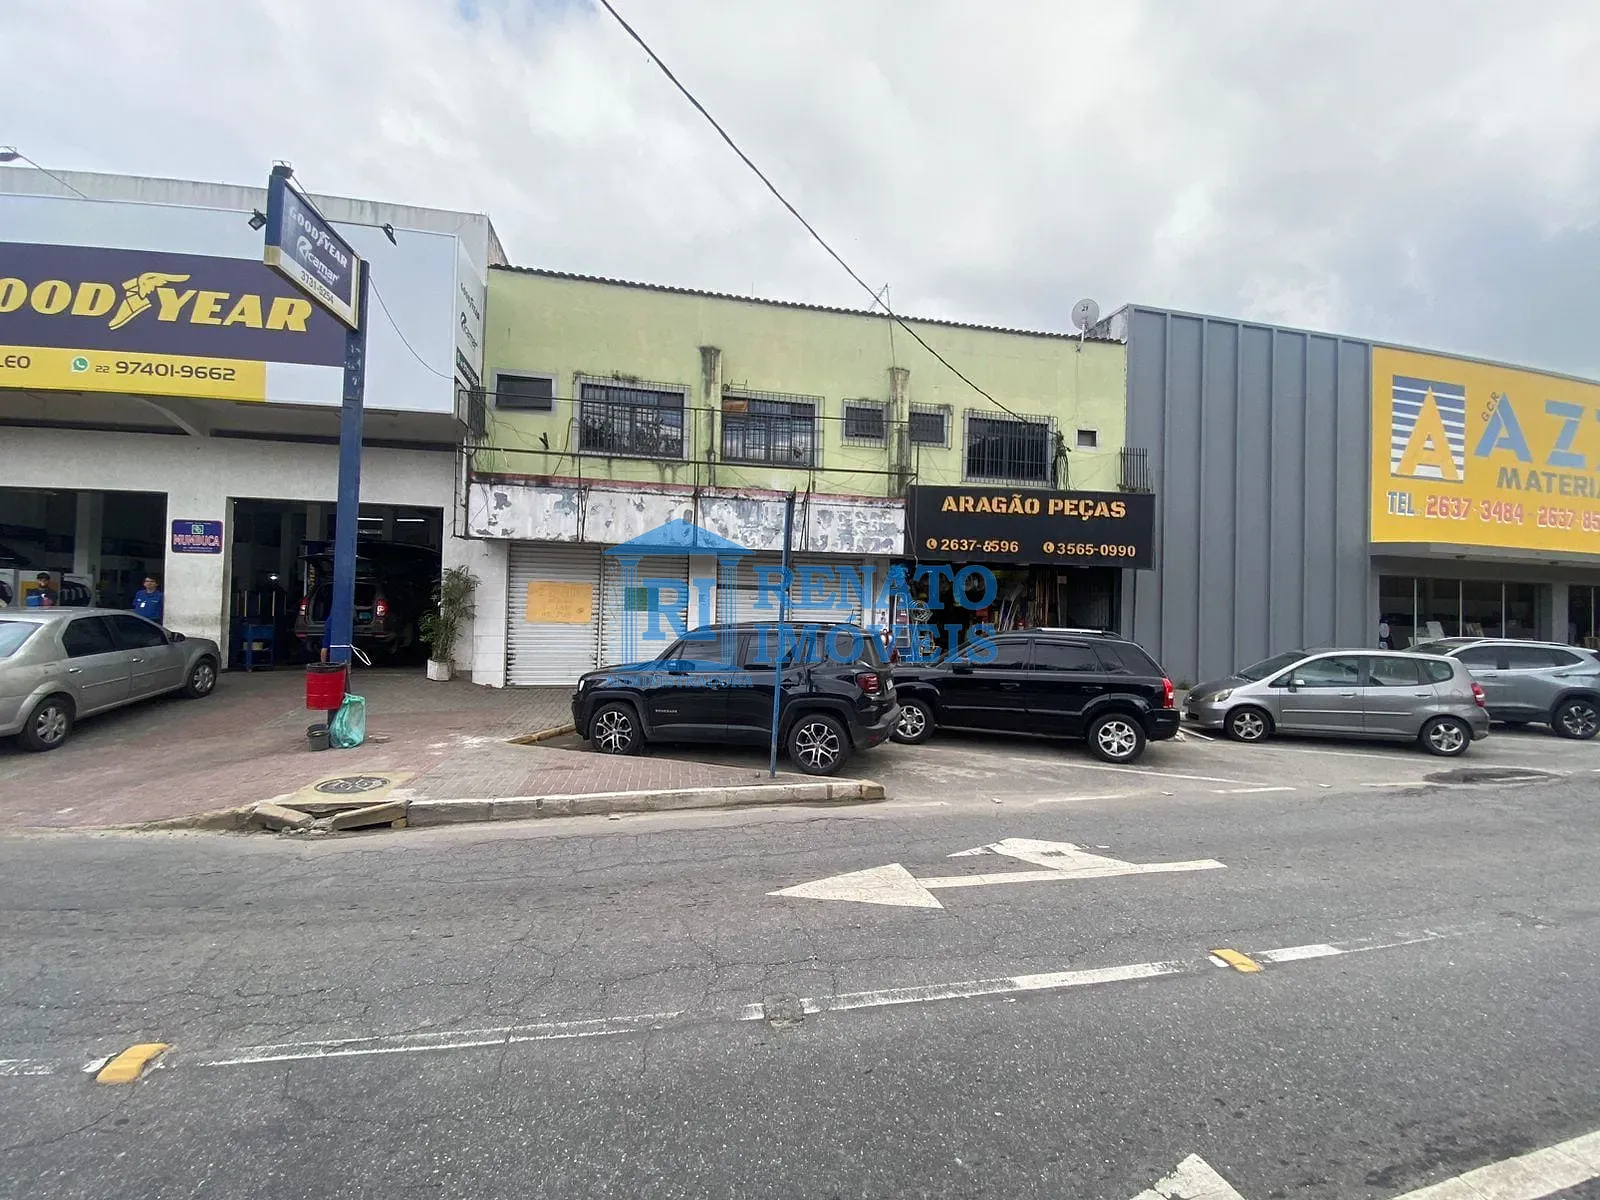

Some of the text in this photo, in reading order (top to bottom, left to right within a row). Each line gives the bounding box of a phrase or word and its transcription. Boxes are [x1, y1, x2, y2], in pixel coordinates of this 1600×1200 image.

[0, 355, 236, 381] EO 22 97401-9662
[1473, 392, 1600, 472] AZ
[941, 494, 1127, 521] ARAGÃO PEÇAS
[940, 539, 1136, 557] 2637-8596 3565-0990
